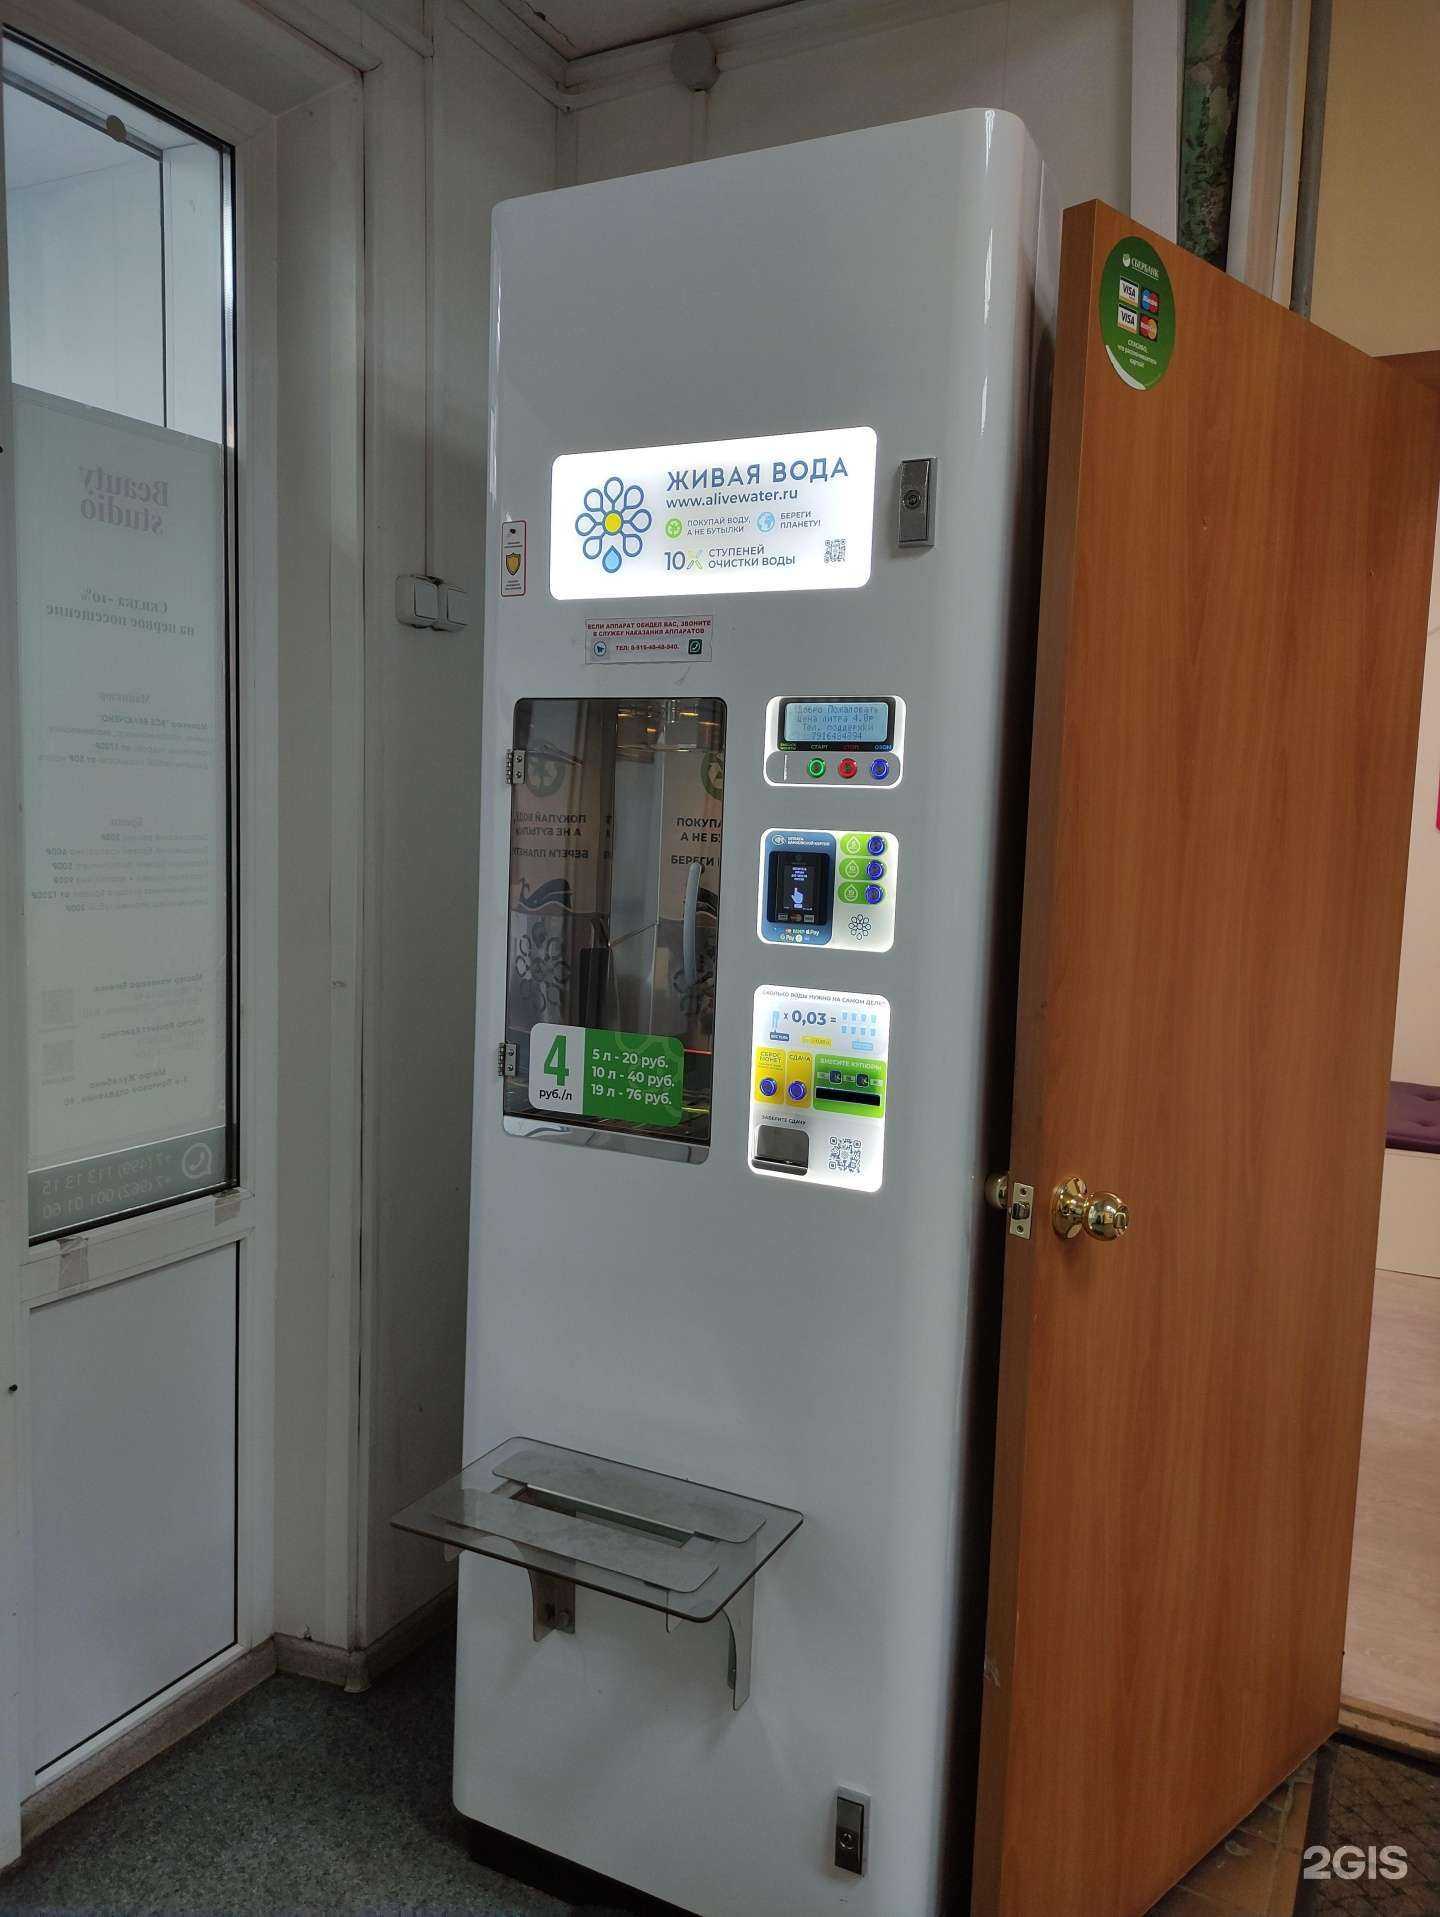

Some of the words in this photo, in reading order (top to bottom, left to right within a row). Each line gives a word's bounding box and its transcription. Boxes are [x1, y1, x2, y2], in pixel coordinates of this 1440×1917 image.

[1131, 257, 1159, 278] СБЕРБАНК
[1121, 282, 1136, 298] VISA
[1120, 310, 1135, 326] VISA
[666, 463, 760, 492] ЖИВАЯ
[772, 457, 849, 484] ВОДА
[665, 488, 798, 509] www.alivewater.ru
[687, 516, 726, 528] ПОКУПАЙ
[780, 511, 812, 520] БЕРЕГИ
[687, 528, 692, 536] А
[694, 528, 705, 536] НЕ
[706, 525, 745, 536] БУТЫЛКИ
[780, 519, 821, 529] ПЛАНЕТУ!
[708, 544, 765, 558] СТУПЕНЕЙ
[663, 551, 686, 570] 10
[708, 556, 759, 569] ОЧИСТКИ
[762, 555, 796, 568] ВОДЫ
[605, 622, 635, 630] АППАРАТ
[636, 621, 662, 629] ОБИДЕЛ
[680, 831, 689, 842] А
[692, 832, 708, 843] НЕ
[790, 992, 806, 1000] ВОДЫ
[791, 1010, 827, 1026] 0,03
[543, 1035, 570, 1086] 4
[592, 1049, 600, 1060] 5
[602, 1053, 612, 1062] л
[622, 1052, 638, 1064] 20
[641, 1055, 669, 1071] руб.
[789, 1054, 811, 1062] СДАЧА
[591, 1066, 605, 1078] 10
[607, 1071, 617, 1080] л
[627, 1071, 645, 1083] 40
[647, 1074, 675, 1090] руб.
[539, 1088, 572, 1101] руб./л
[591, 1084, 604, 1096] 19
[606, 1088, 615, 1098] л
[626, 1088, 642, 1101] 76
[644, 1092, 672, 1107] руб.
